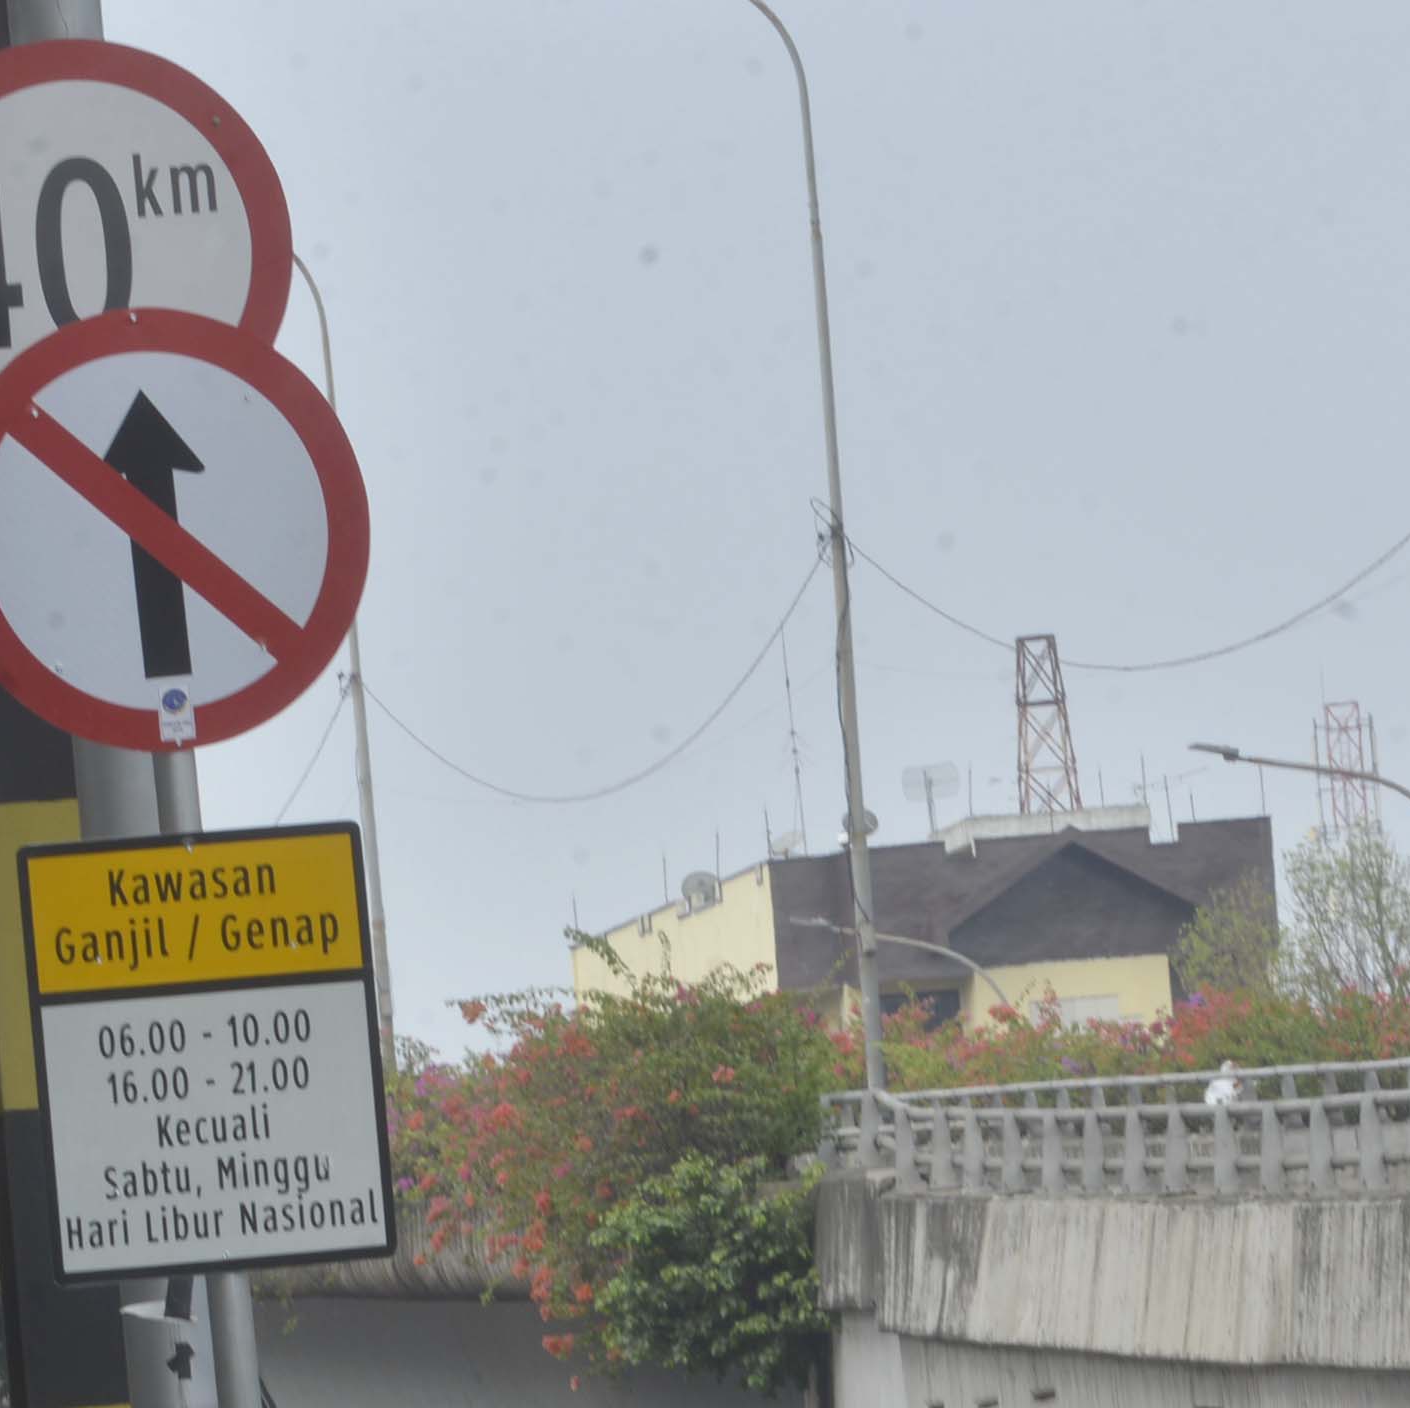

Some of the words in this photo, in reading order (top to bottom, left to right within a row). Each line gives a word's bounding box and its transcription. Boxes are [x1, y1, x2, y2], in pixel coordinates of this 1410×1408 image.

[132, 153, 219, 219] km
[107, 862, 277, 907] Kawasan
[55, 918, 170, 971] Ganjil
[187, 914, 200, 962] /
[221, 911, 341, 956] Genap
[98, 1019, 187, 1059] 06.00
[226, 1008, 312, 1049] 10.00
[106, 1066, 190, 1107] 16.00
[230, 1056, 310, 1097] 21.00
[156, 1102, 272, 1149] Kecuali
[104, 1160, 203, 1201] Sabtu,
[217, 1152, 331, 1195] Minggu
[65, 1207, 130, 1252] Hari
[145, 1203, 224, 1244] Libur
[239, 1188, 380, 1237] Nasional
